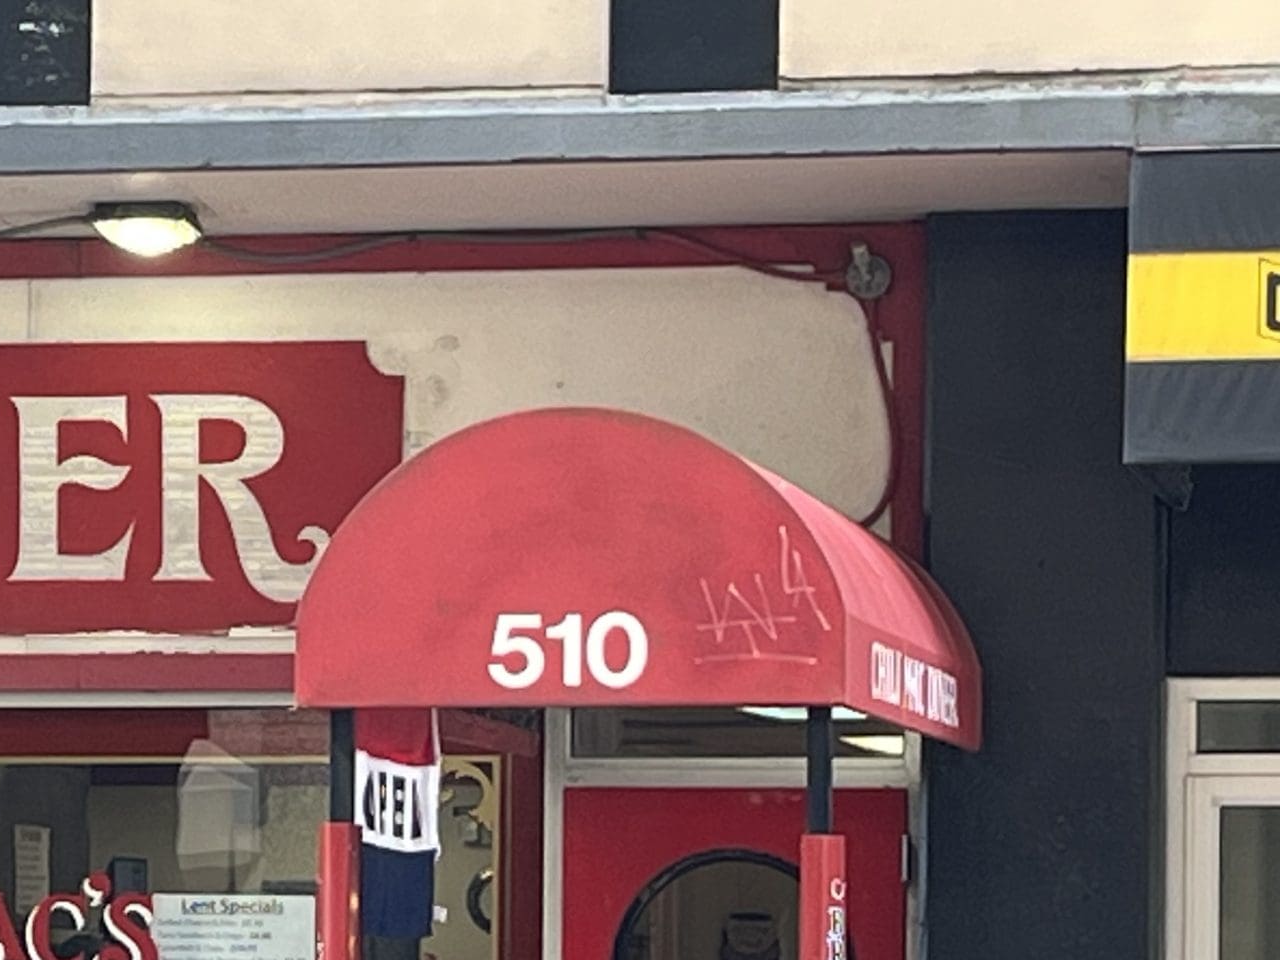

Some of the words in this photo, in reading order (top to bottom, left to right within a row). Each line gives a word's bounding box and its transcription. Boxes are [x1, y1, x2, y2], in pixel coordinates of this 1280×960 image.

[487, 611, 648, 689] 510
[181, 898, 216, 915] Lent
[219, 898, 284, 916] Specials
